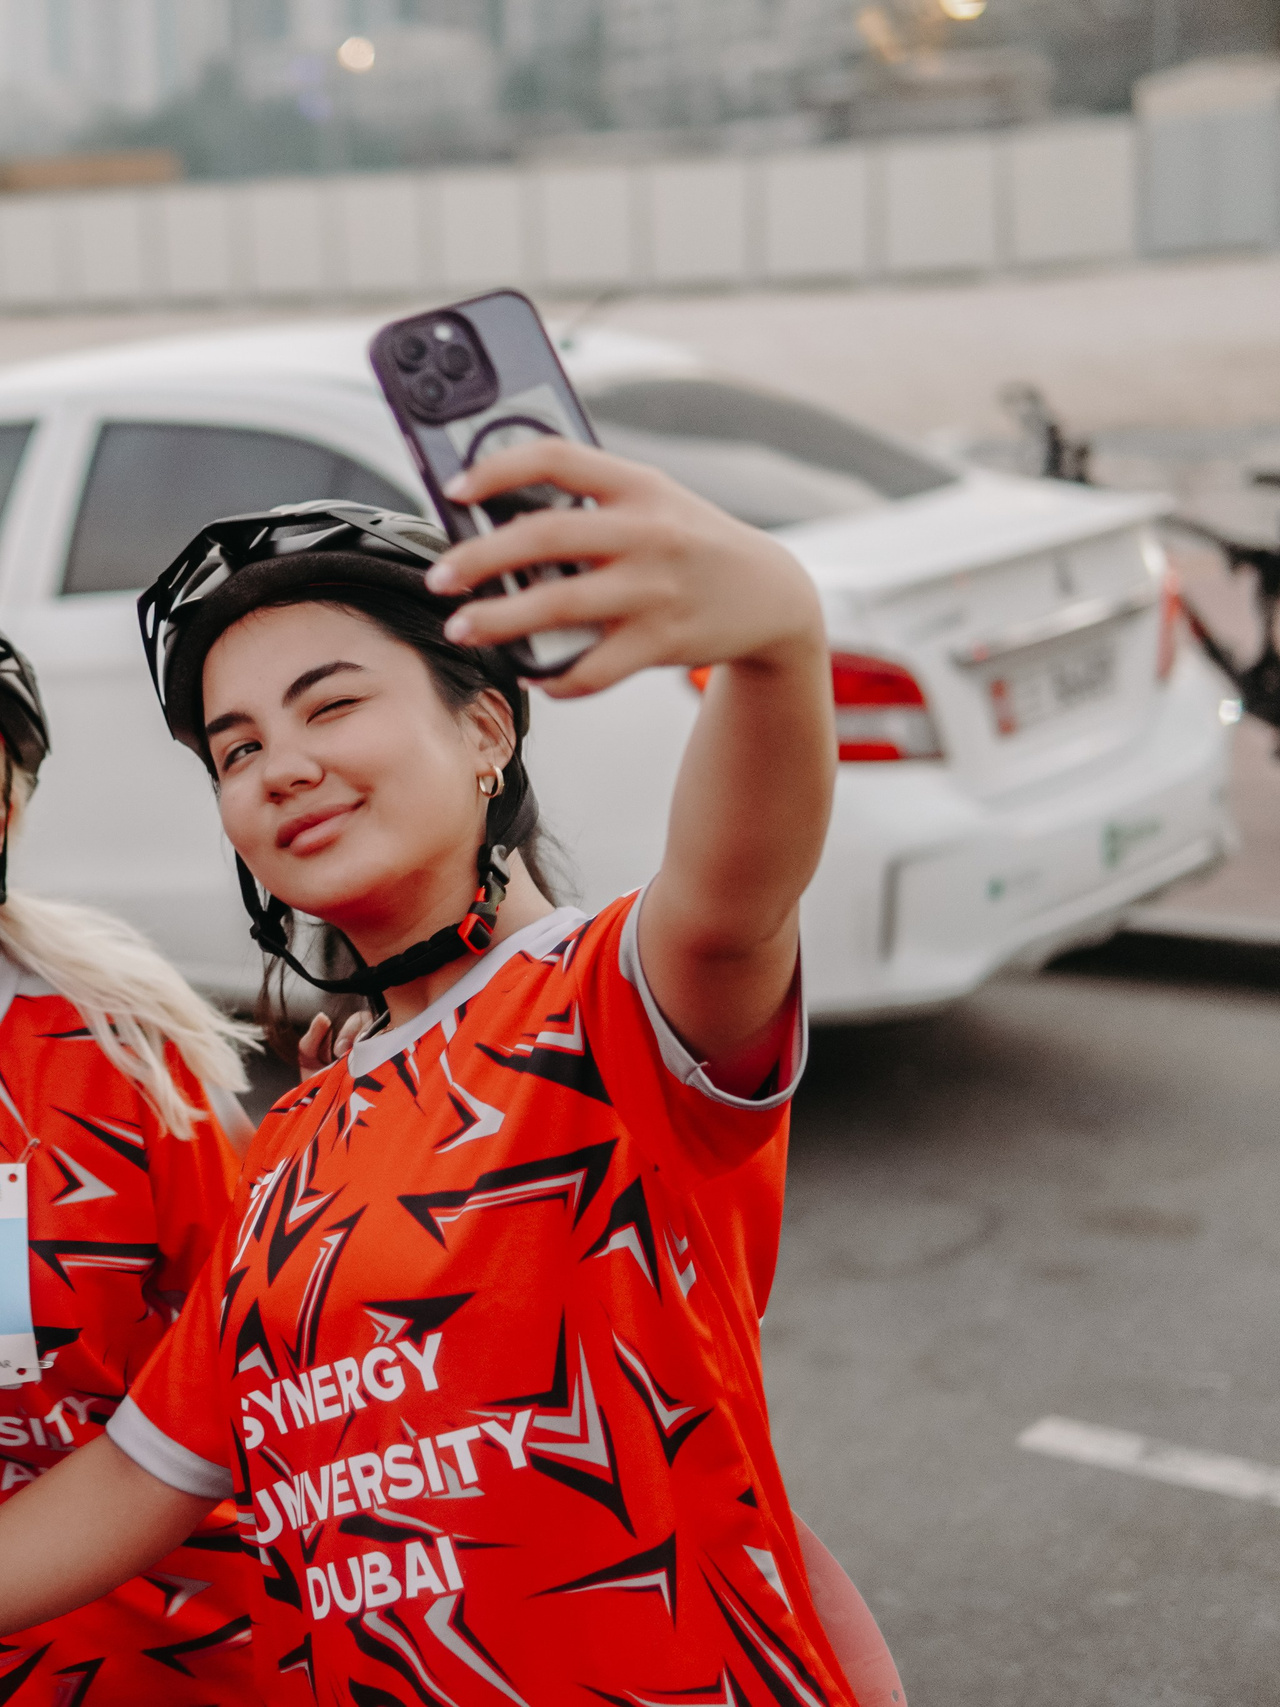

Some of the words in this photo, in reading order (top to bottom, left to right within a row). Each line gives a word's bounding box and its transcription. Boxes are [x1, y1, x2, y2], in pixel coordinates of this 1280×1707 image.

[241, 1332, 443, 1450] SYNERGY
[255, 1409, 533, 1545] UNIVERSITY
[306, 1536, 464, 1620] DUBAI
